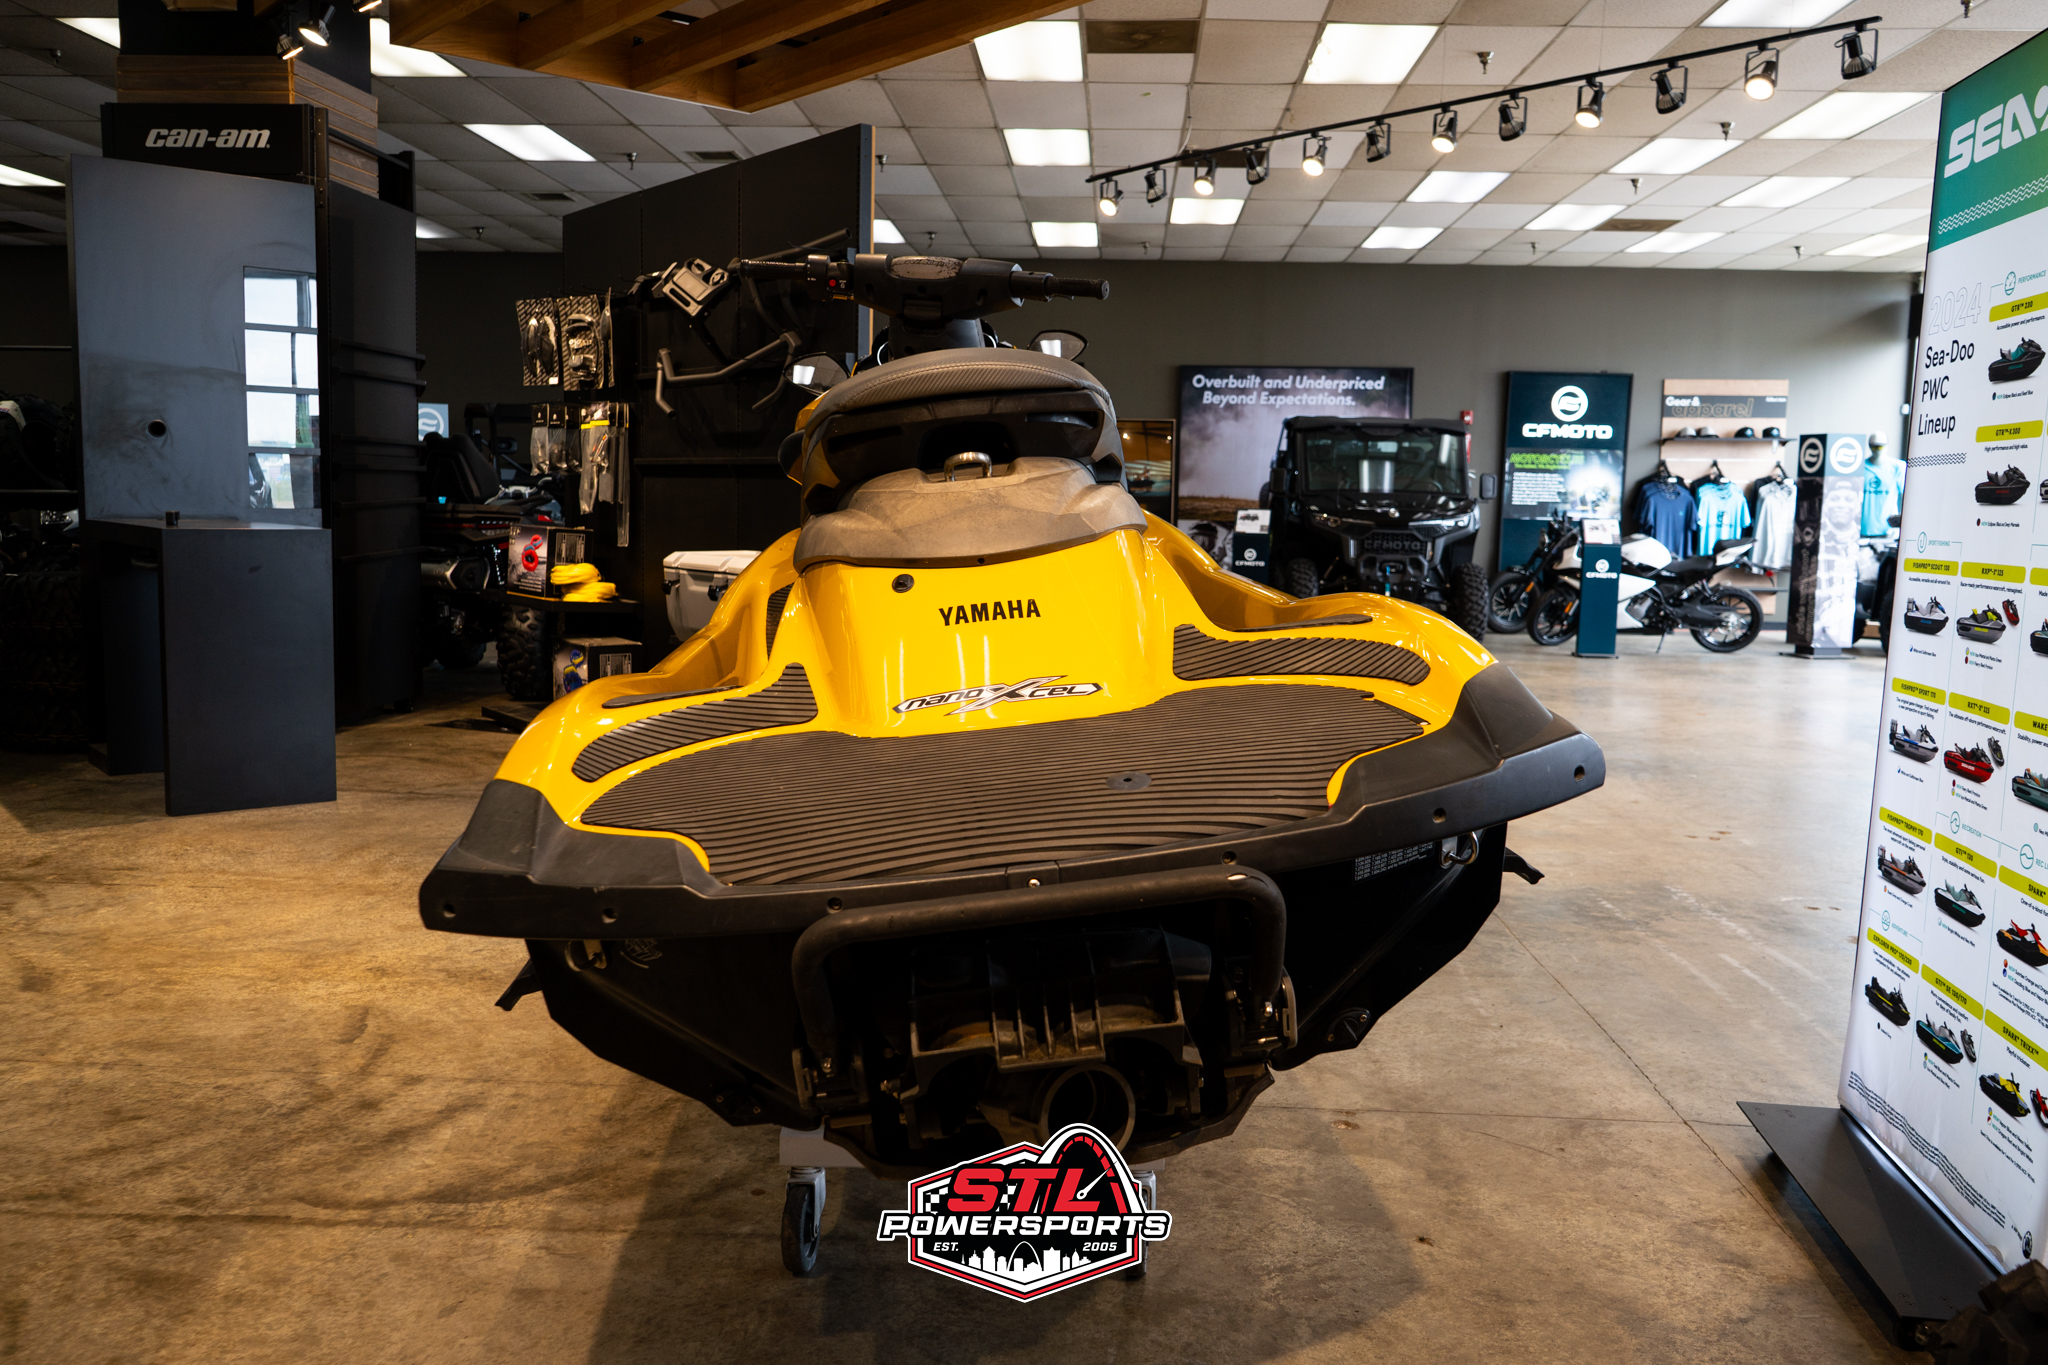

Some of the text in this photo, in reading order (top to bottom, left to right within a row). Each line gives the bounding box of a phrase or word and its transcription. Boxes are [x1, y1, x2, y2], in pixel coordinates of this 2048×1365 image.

[1928, 282, 1981, 335] 2024
[1925, 340, 1975, 369] Sea-Doo
[1192, 374, 1385, 393] Overbuilt and Underpriced
[1921, 375, 1950, 403] PWC
[1202, 391, 1356, 408] Beyond Expectations.
[1665, 395, 1692, 407] Gear
[1672, 397, 1755, 418] apparel
[1522, 423, 1614, 440] CFMOTO
[1918, 413, 1956, 439] Lineup
[1364, 540, 1422, 550] CFMOTO
[938, 598, 1041, 627] YAMAHA
[1918, 688, 1930, 697] SPORT
[2031, 738, 2043, 747] power
[1904, 822, 1917, 833] TROPHY
[1962, 823, 1982, 838] RECREATION
[2036, 859, 2044, 868] REC
[1891, 922, 1908, 938] ADVENTURE
[1873, 934, 1890, 950] EXPLORER
[1946, 985, 1951, 994] SE
[2006, 1046, 2017, 1059] Playful
